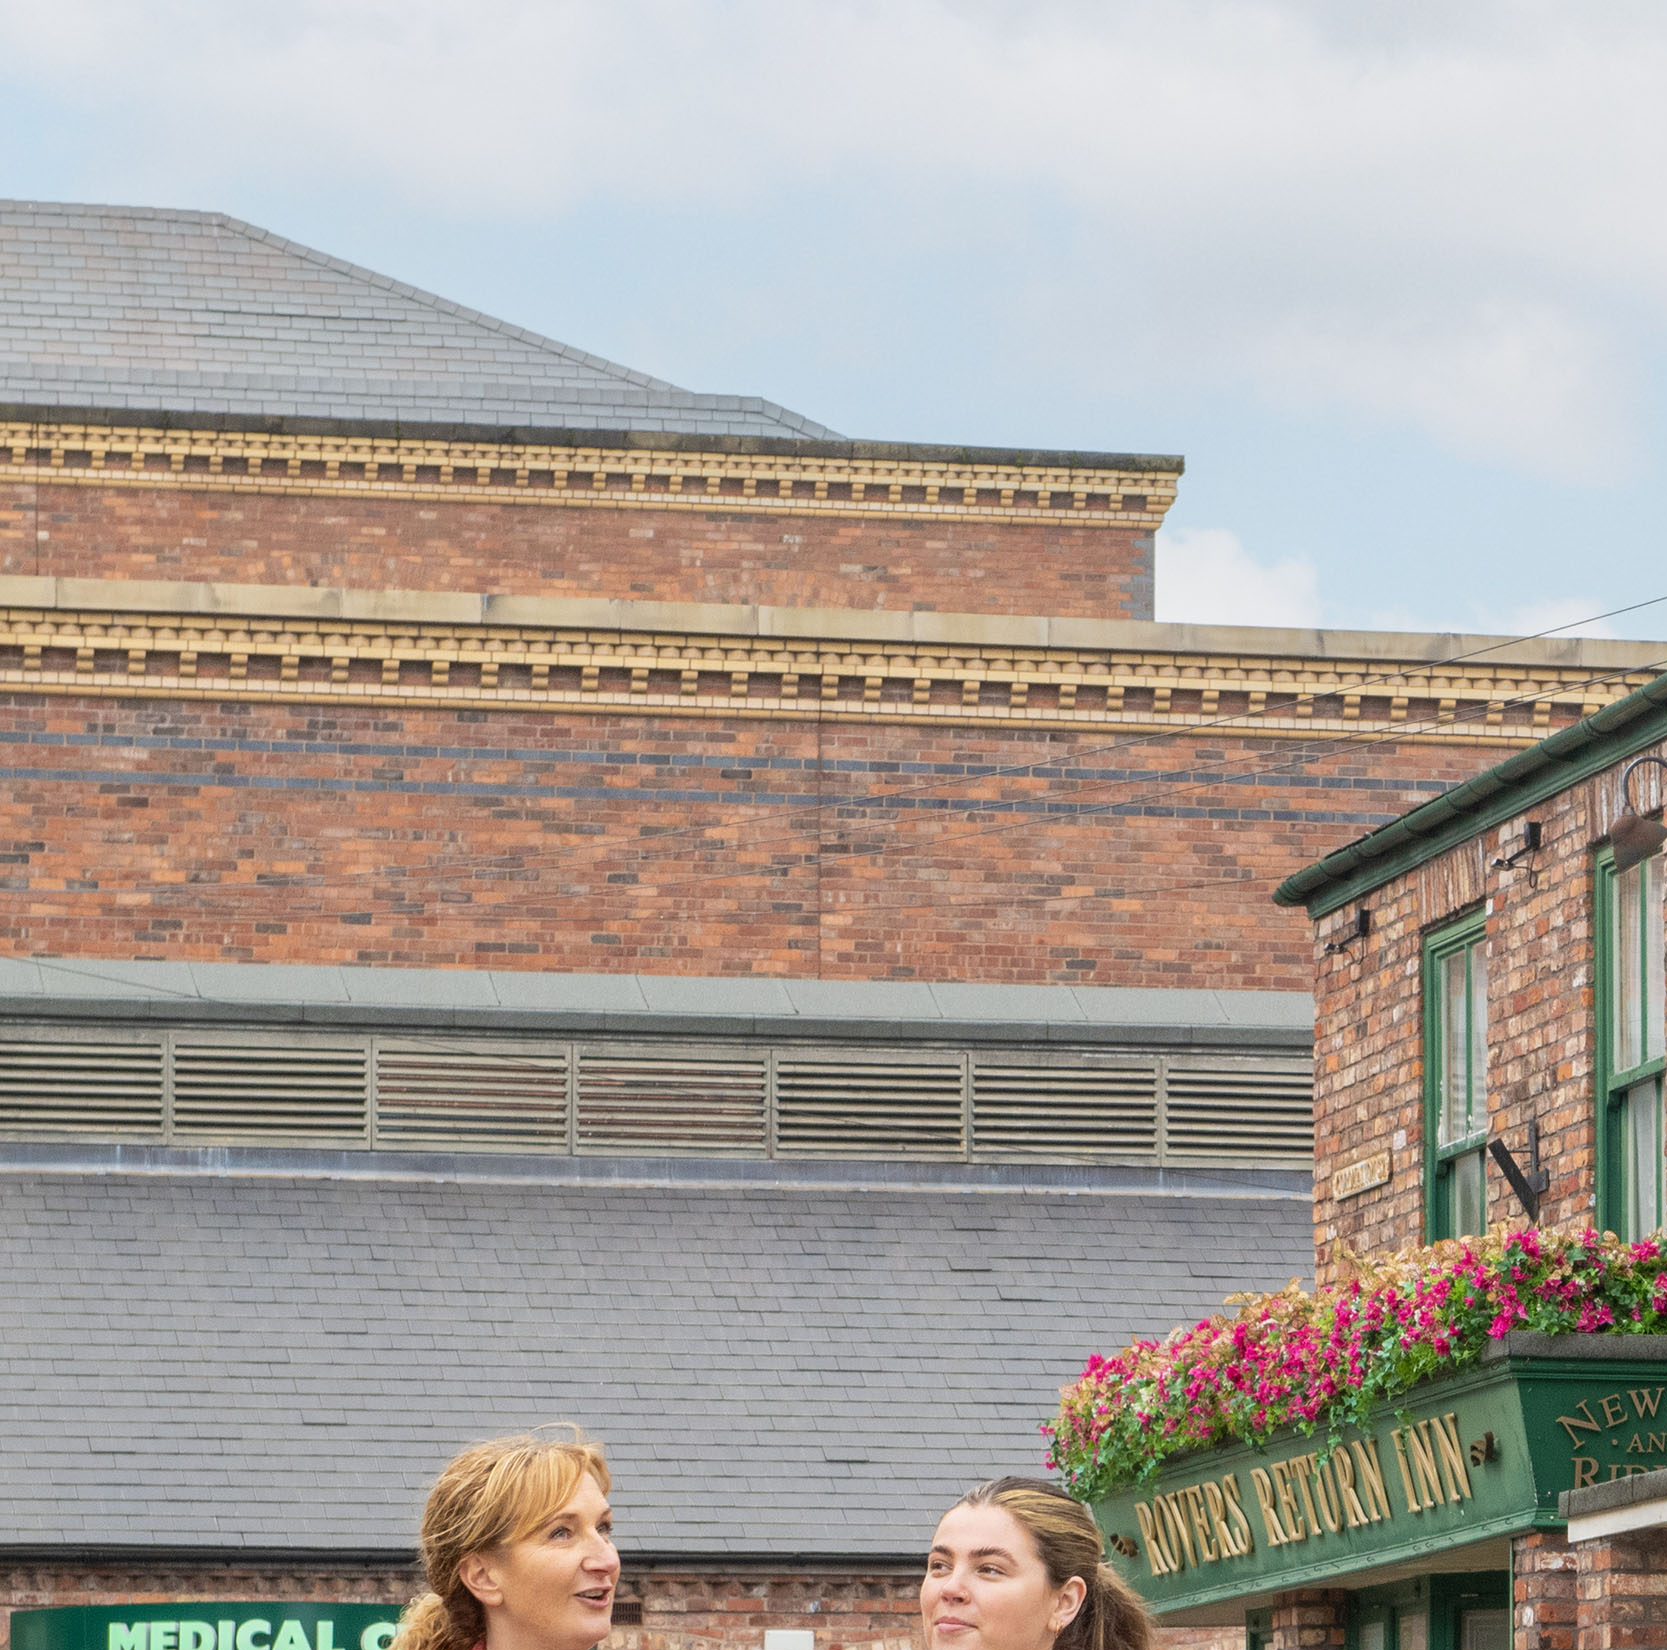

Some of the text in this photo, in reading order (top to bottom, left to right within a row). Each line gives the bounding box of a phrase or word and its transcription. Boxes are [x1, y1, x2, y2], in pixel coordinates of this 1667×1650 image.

[1134, 1412, 1472, 1577] ROVERS RETURN INN
